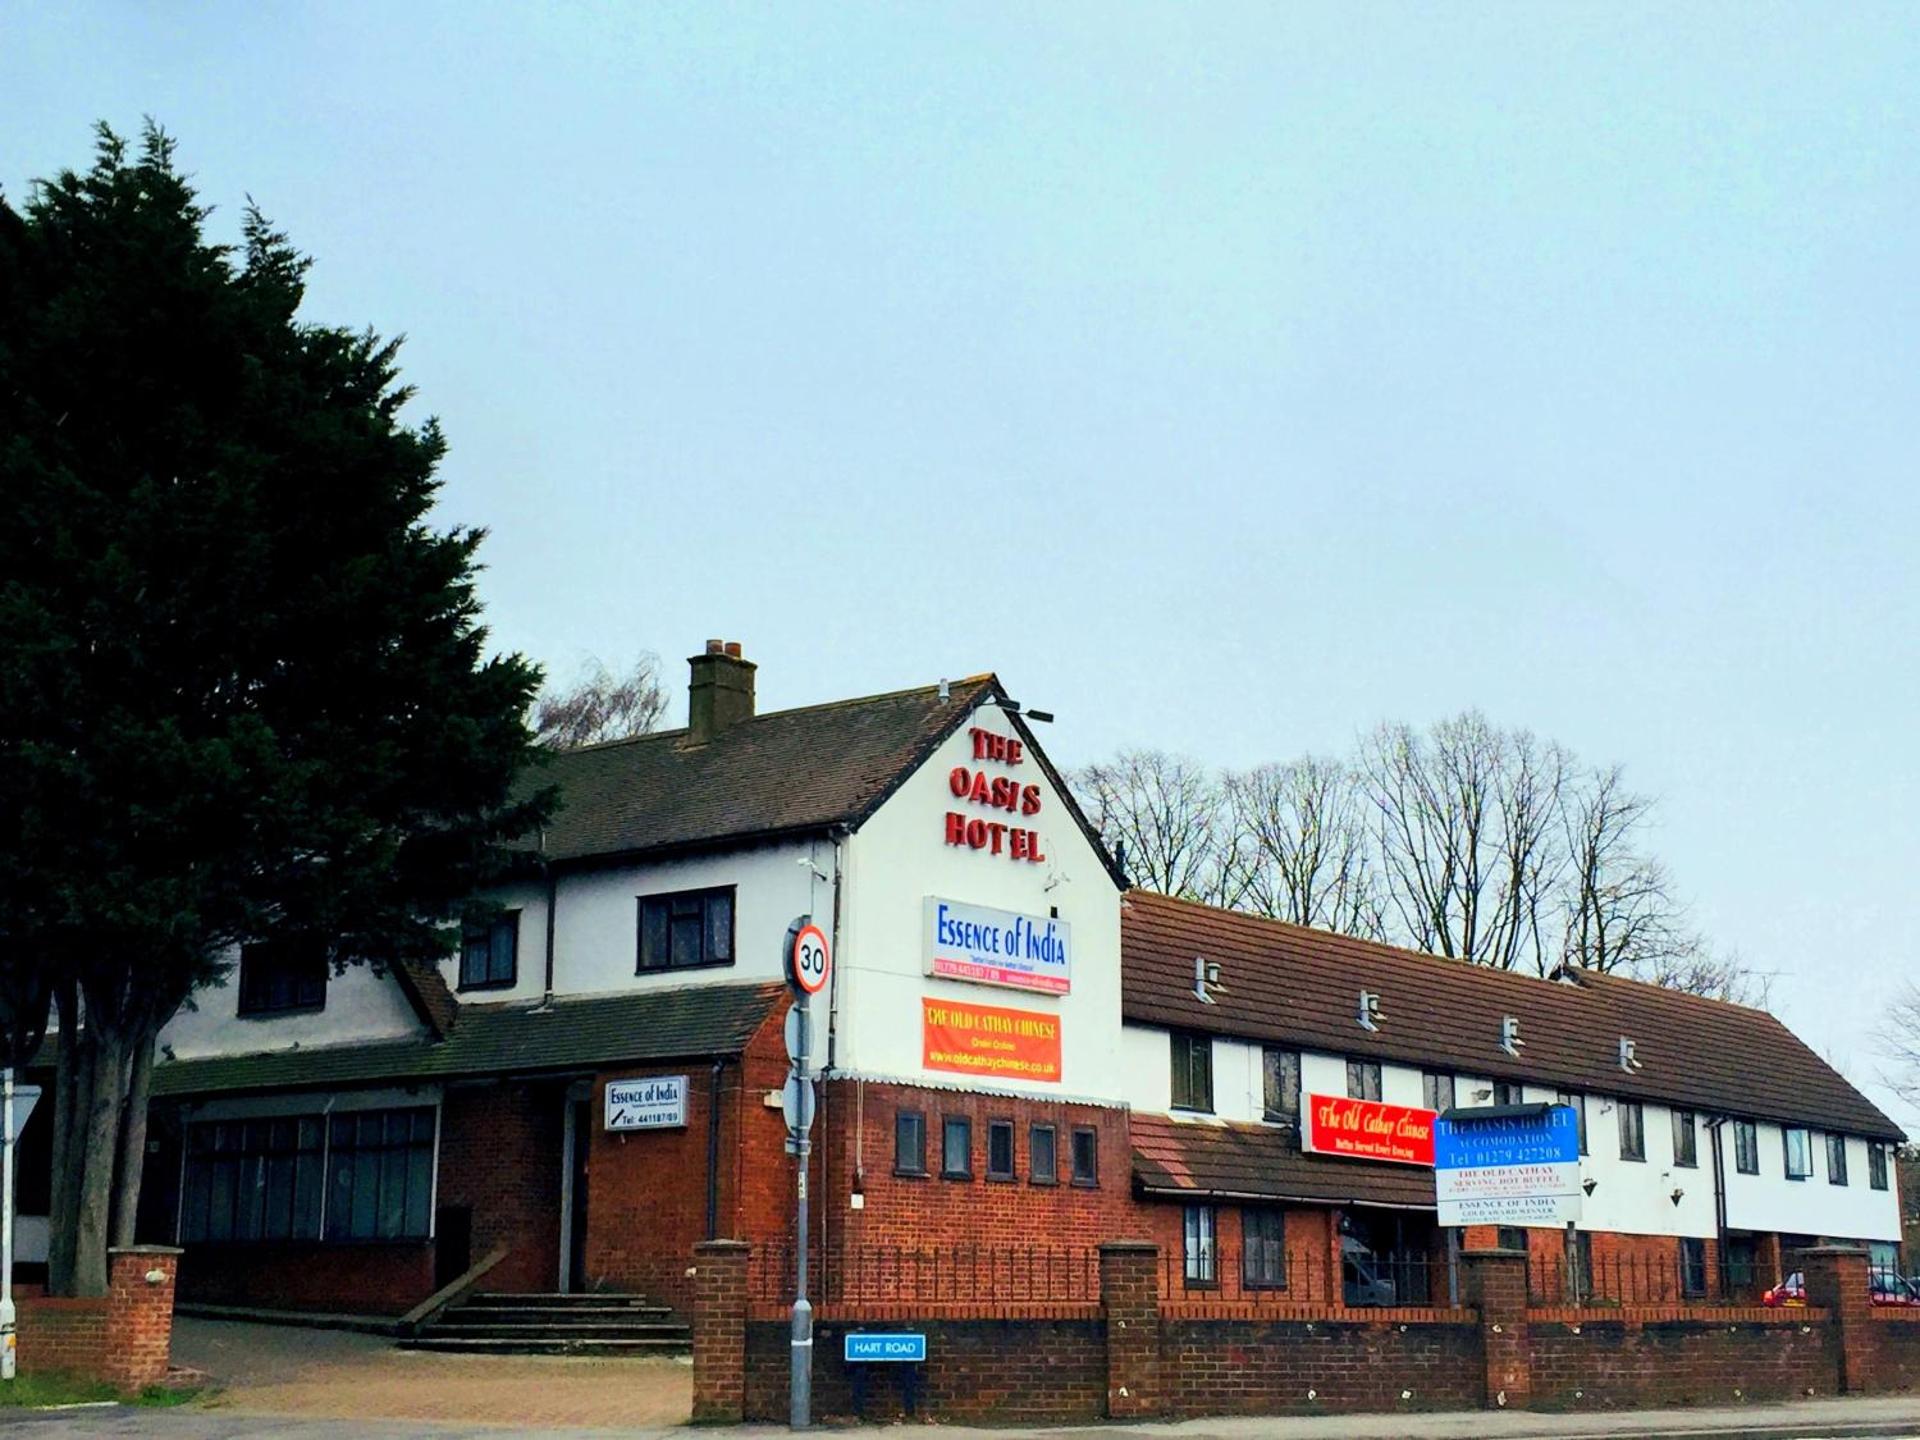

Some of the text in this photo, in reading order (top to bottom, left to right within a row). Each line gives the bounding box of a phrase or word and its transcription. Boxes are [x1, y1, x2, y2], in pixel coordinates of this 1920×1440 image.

[968, 727, 1024, 765] THE
[949, 767, 1041, 816] OASIS
[945, 811, 1046, 863] HOTEL
[1005, 916, 1023, 957] of
[801, 944, 824, 974] 30
[928, 1007, 1055, 1040] THE OLD CATHAY CHINESE
[645, 1084, 655, 1101] of
[1319, 1100, 1340, 1129] The
[1343, 1102, 1363, 1131] Old
[1363, 1106, 1394, 1146] Cathay
[1438, 1112, 1569, 1136] THE OASIS HOTEL
[1449, 1147, 1562, 1166] Tel 01279 427208
[1459, 1166, 1554, 1179] THE OLD CATHAY
[1459, 1197, 1557, 1210] ESSENCE OF INDIA
[855, 1342, 916, 1353] HART ROAD
